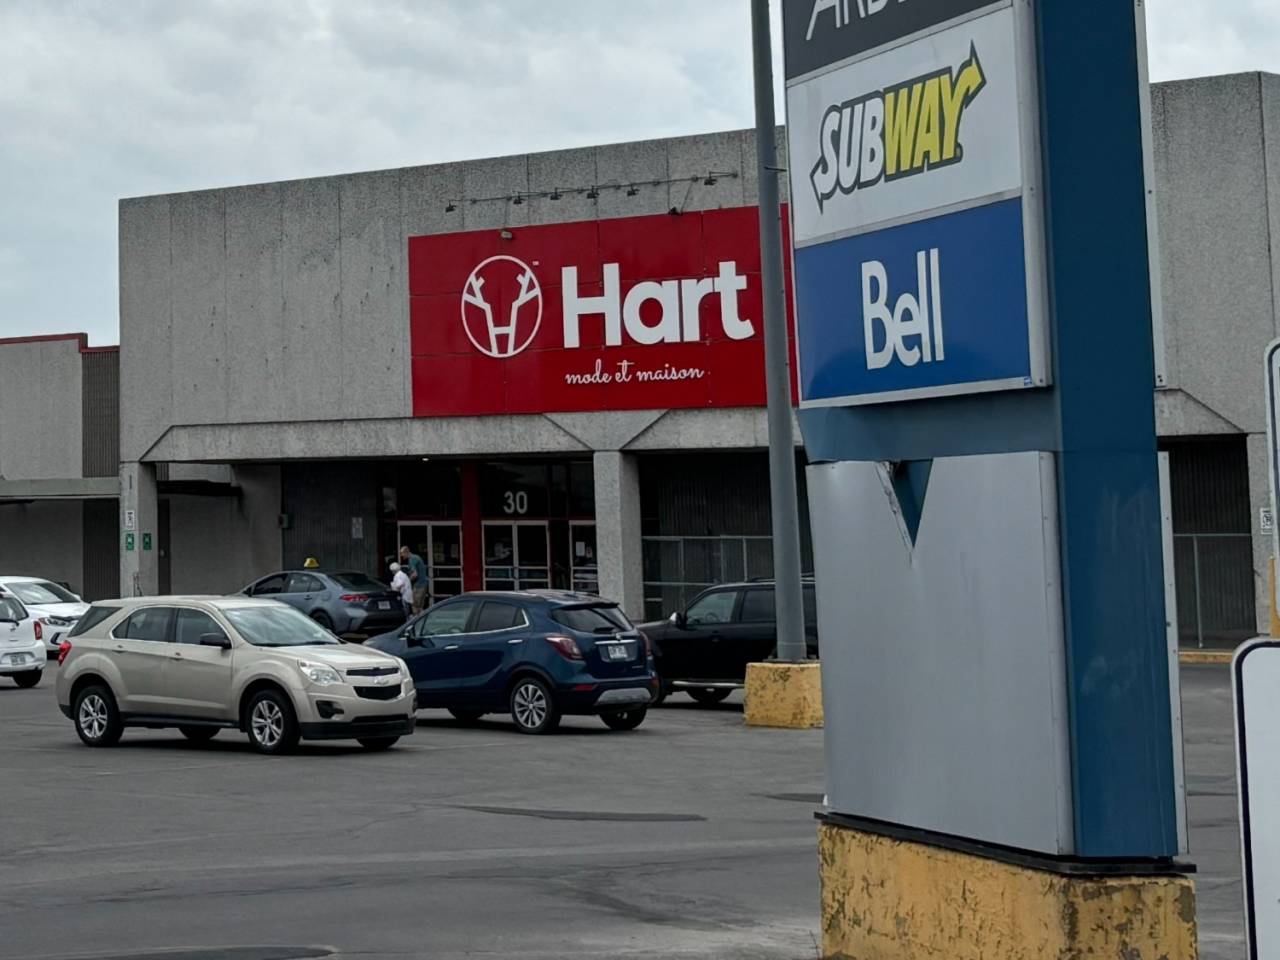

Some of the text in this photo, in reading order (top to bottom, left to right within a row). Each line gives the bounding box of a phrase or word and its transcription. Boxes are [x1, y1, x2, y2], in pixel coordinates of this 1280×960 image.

[815, 48, 985, 202] SUBWAY
[561, 260, 756, 349] Hart
[861, 247, 945, 370] Bell
[564, 358, 705, 385] mode et maison
[503, 491, 528, 514] 30
